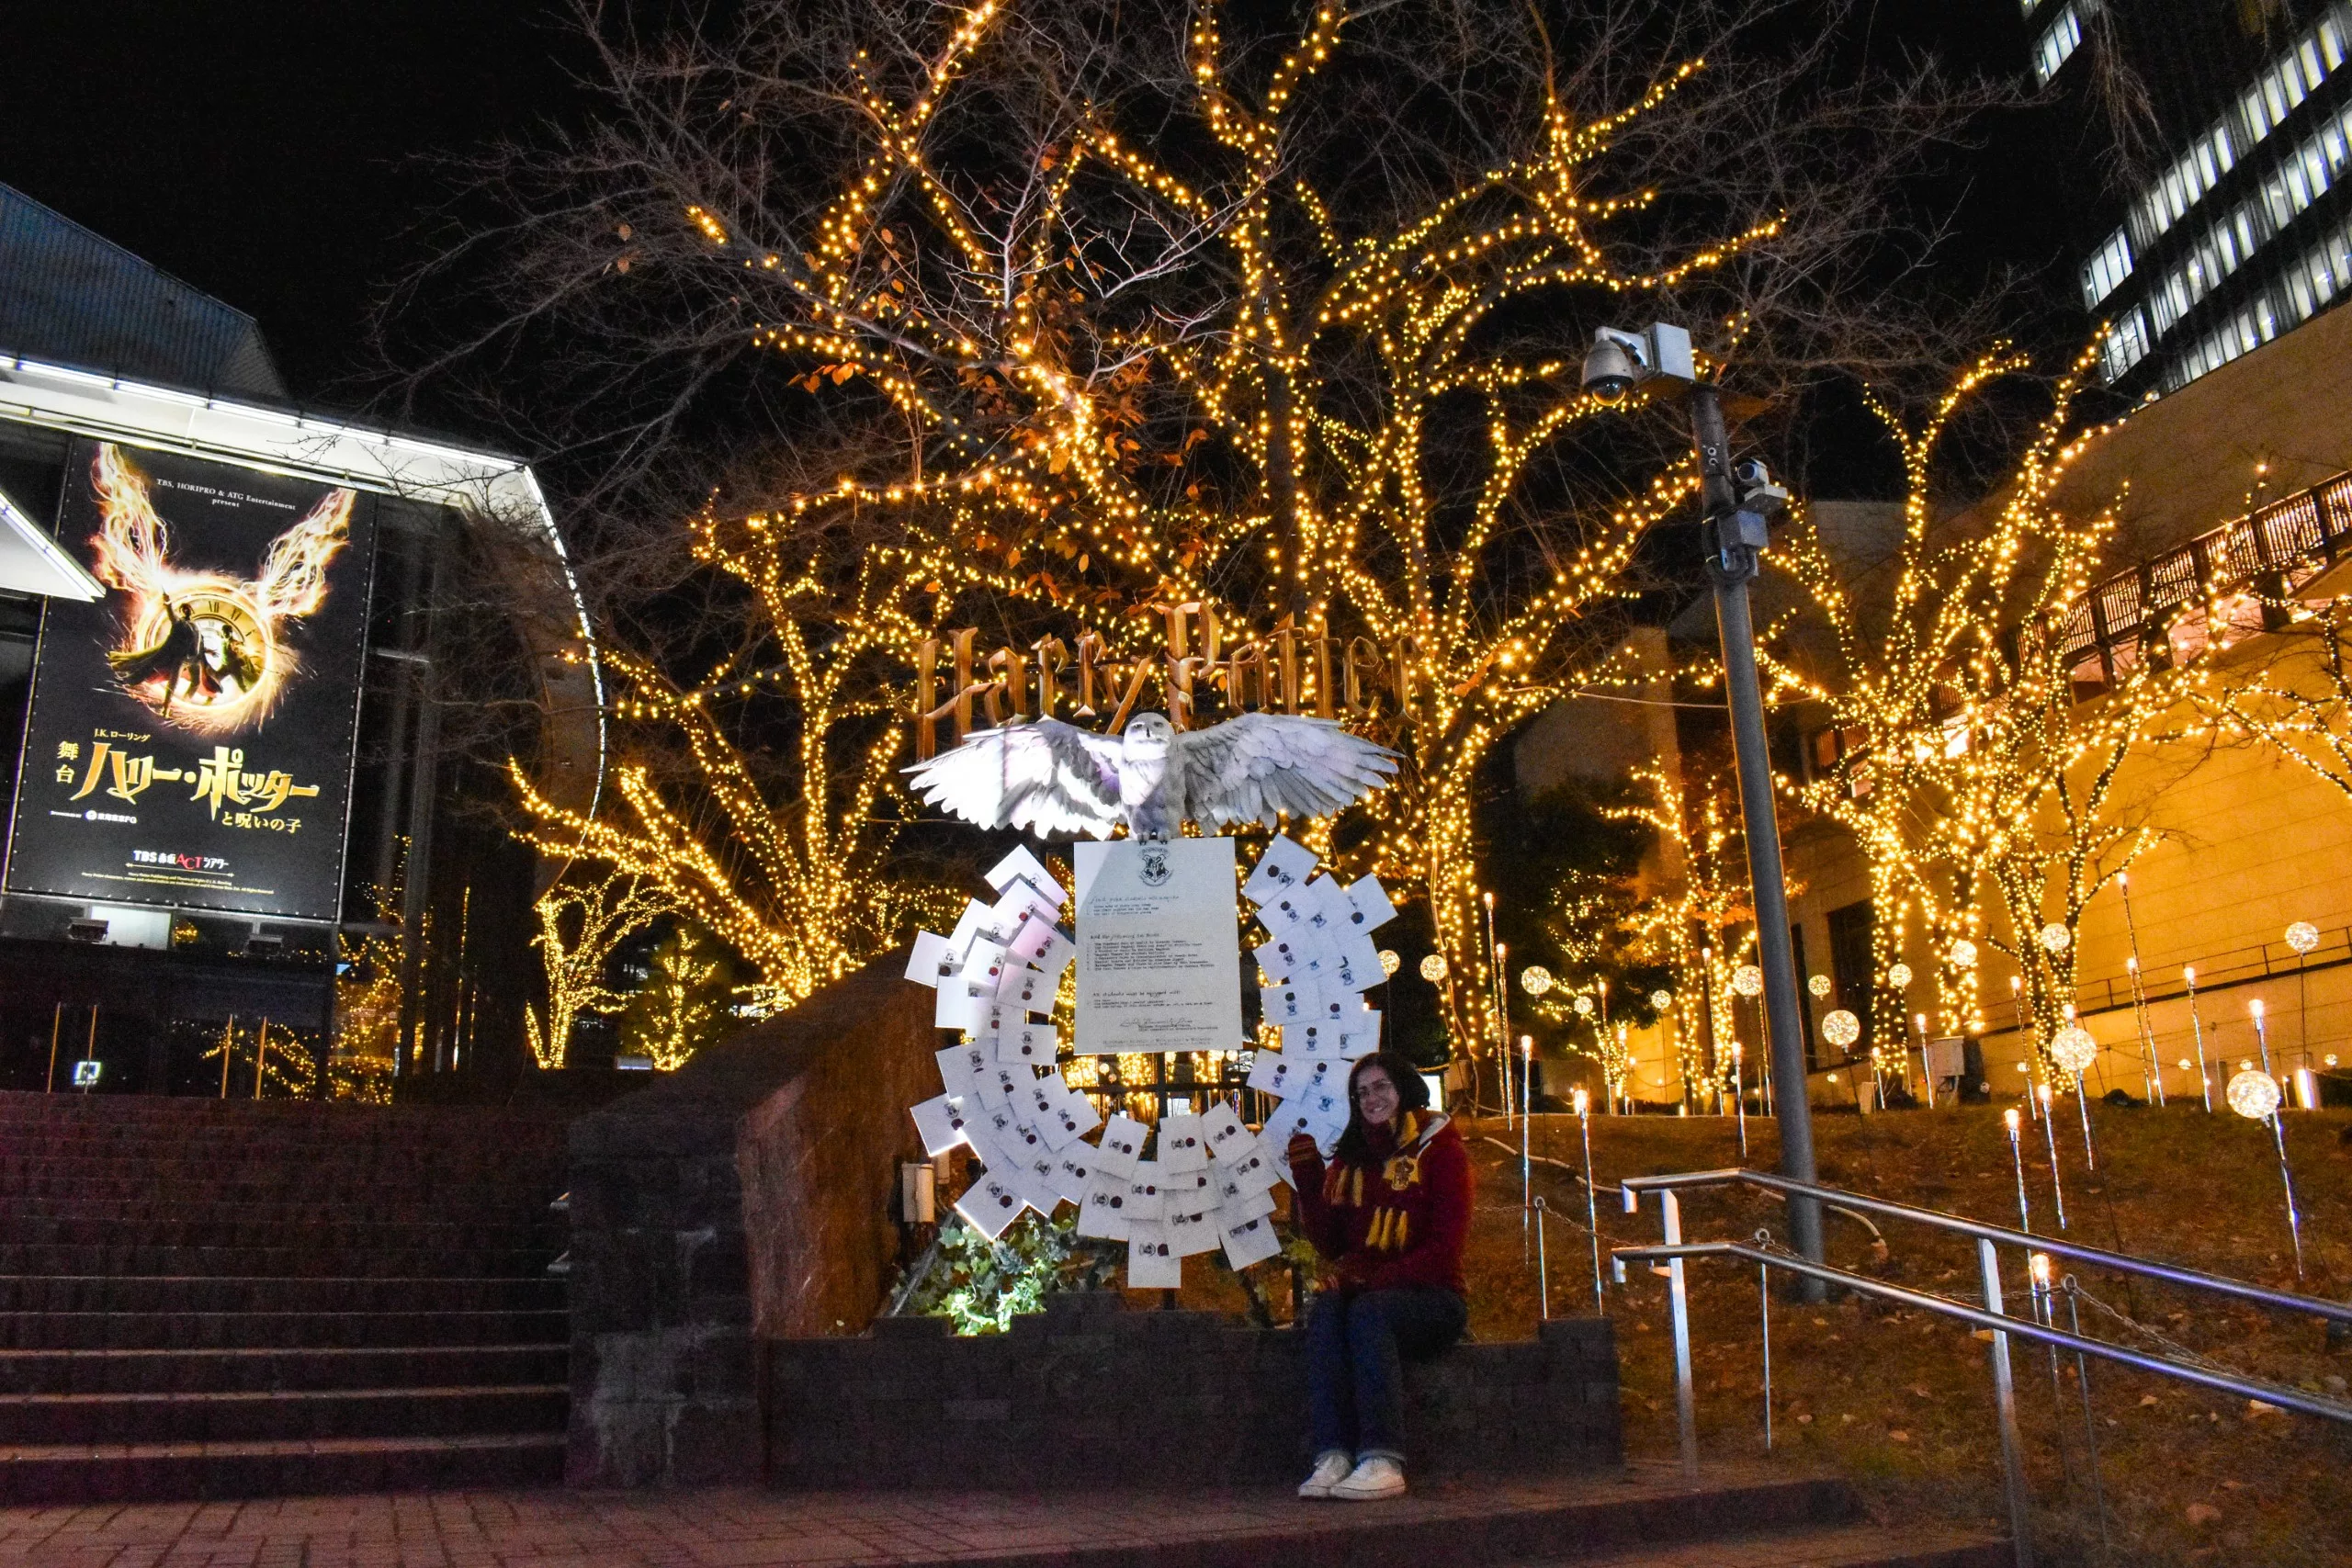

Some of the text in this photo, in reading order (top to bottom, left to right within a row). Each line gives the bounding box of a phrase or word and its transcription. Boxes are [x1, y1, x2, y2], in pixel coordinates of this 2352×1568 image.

[156, 479, 174, 488] TBS,
[177, 482, 216, 494] HORIPRO
[227, 491, 244, 500] ATG
[246, 495, 296, 510] Entertainment
[211, 499, 240, 507] present
[896, 602, 1428, 763] Harry Potter
[55, 740, 79, 784] 舞台
[221, 811, 301, 834] と呪いの子
